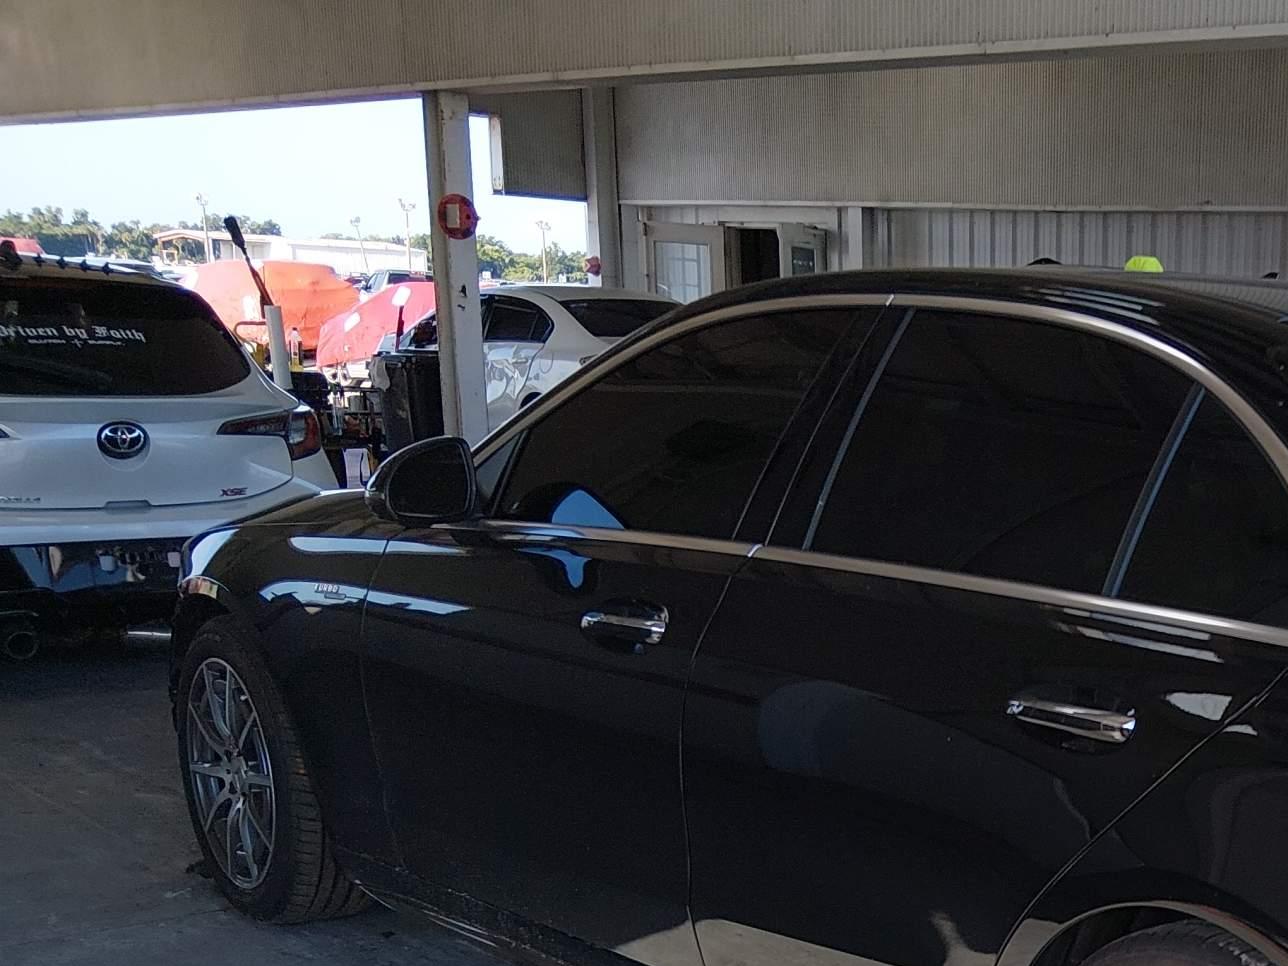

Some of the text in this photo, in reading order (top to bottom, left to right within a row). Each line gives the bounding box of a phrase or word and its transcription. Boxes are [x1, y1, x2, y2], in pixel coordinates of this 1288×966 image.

[62, 325, 89, 339] by
[91, 325, 146, 343] Faith
[220, 487, 249, 497] XSE
